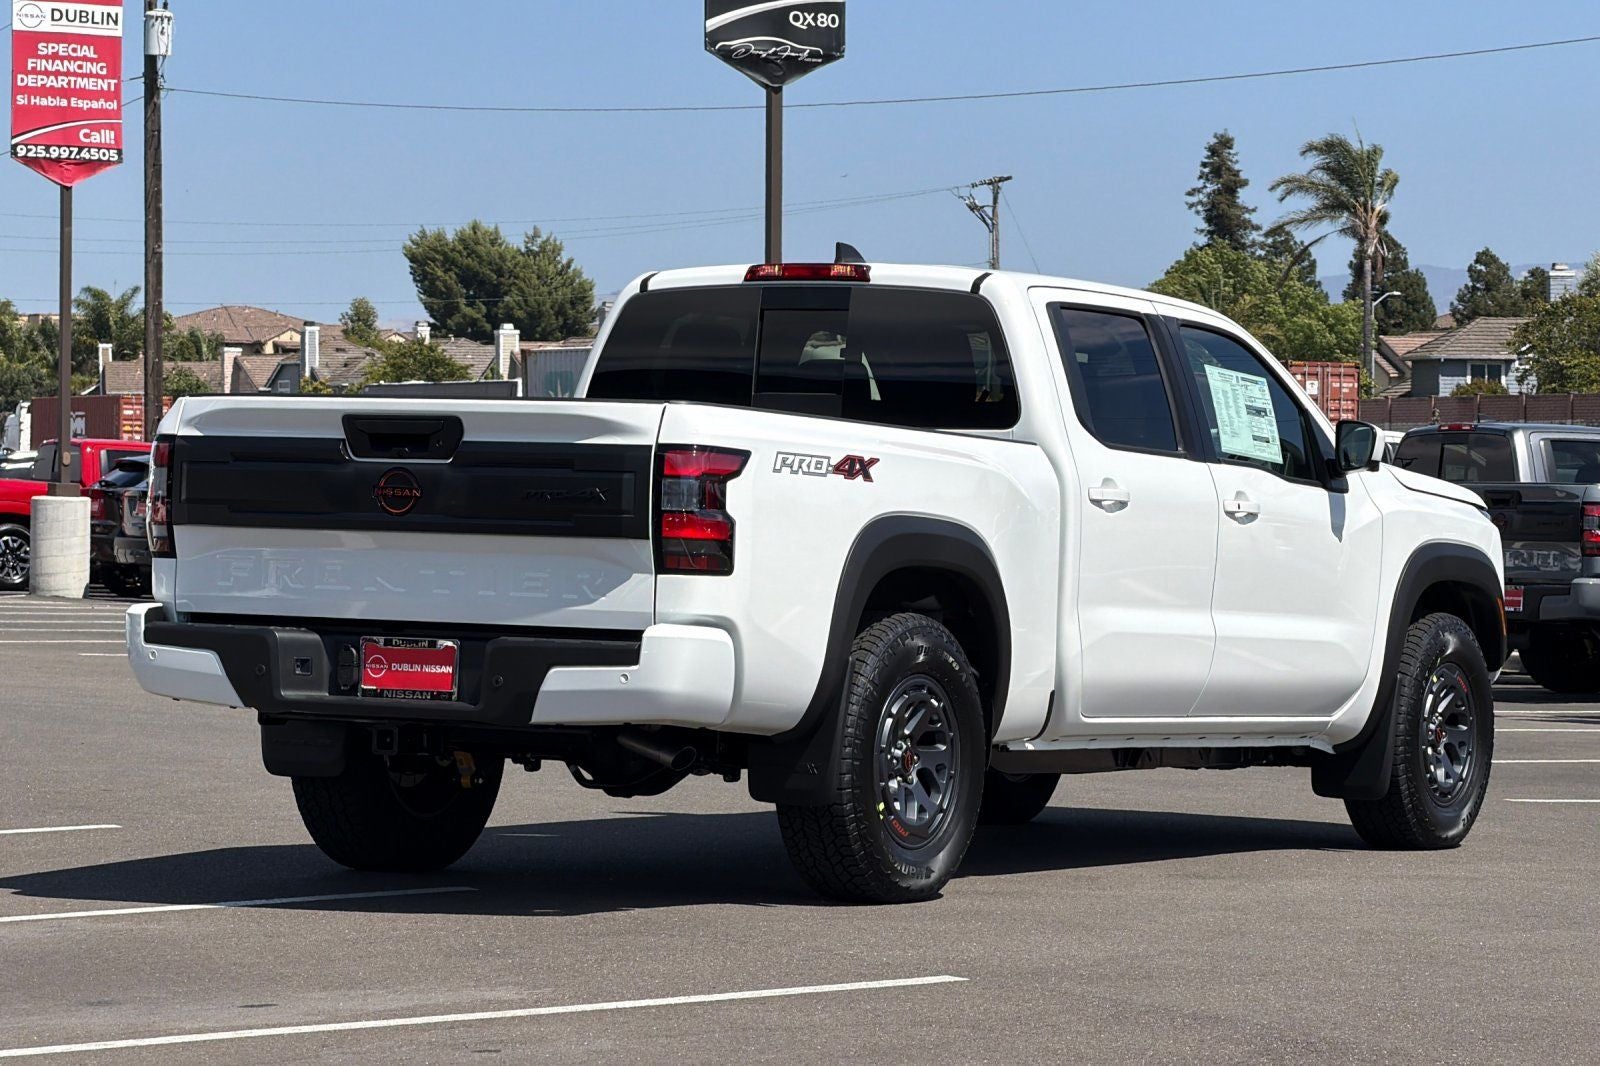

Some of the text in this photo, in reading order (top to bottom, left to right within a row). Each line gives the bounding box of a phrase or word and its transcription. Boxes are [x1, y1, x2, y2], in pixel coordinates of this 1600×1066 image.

[51, 8, 119, 26] DUBLIN
[789, 11, 839, 30] QX80
[37, 43, 98, 58] SPECIAL
[27, 59, 107, 75] FINANCING
[17, 74, 118, 91] DEPARTMENT
[16, 94, 118, 111] Si Habla Español
[79, 129, 115, 144] Call!
[16, 145, 119, 161] 925.997.4505
[391, 663, 421, 672] DUBLIN
[422, 664, 453, 674] NISSAN
[383, 689, 431, 699] NISSAN
